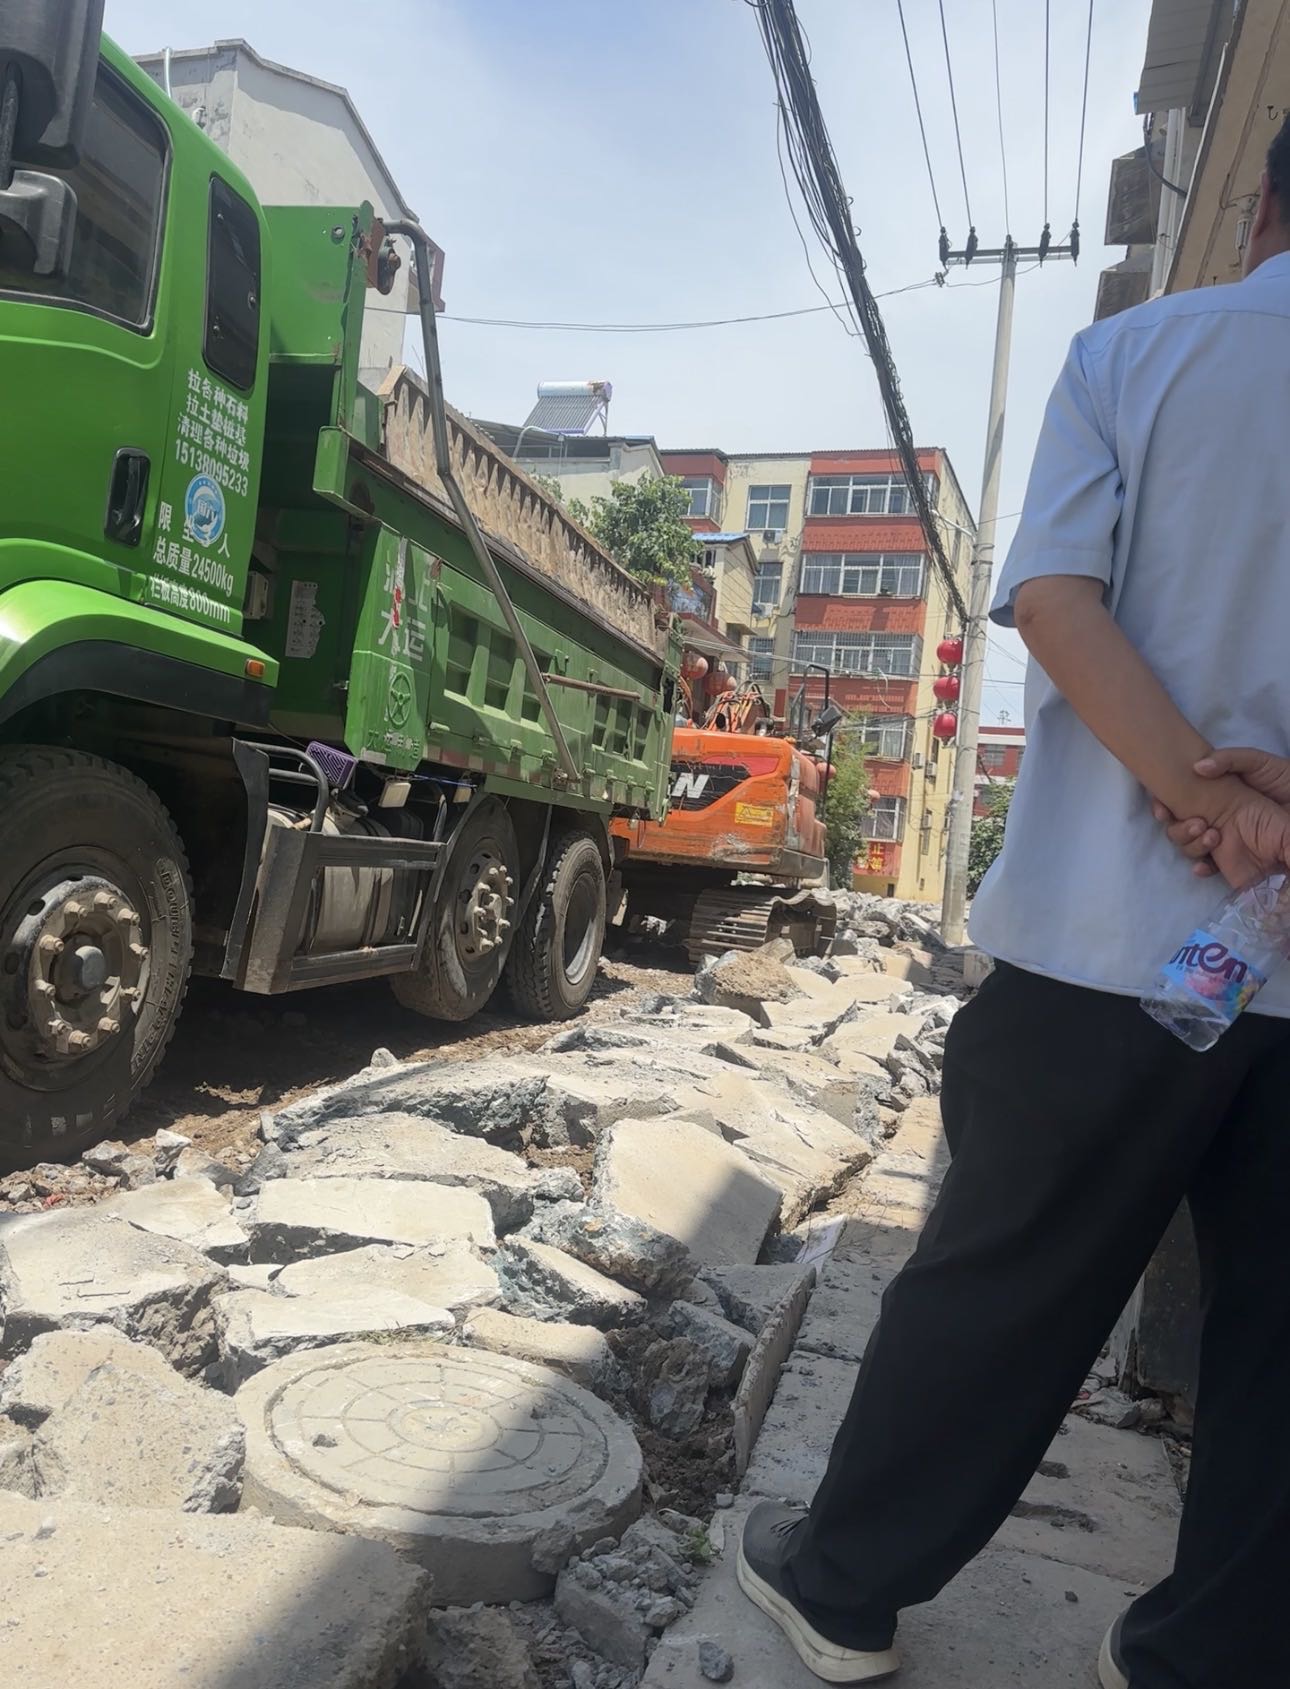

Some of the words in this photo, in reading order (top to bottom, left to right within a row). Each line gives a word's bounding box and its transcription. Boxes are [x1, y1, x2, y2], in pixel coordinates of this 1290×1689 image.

[175, 438, 248, 497] 15138095233
[153, 537, 234, 597] 总质量24500kg
